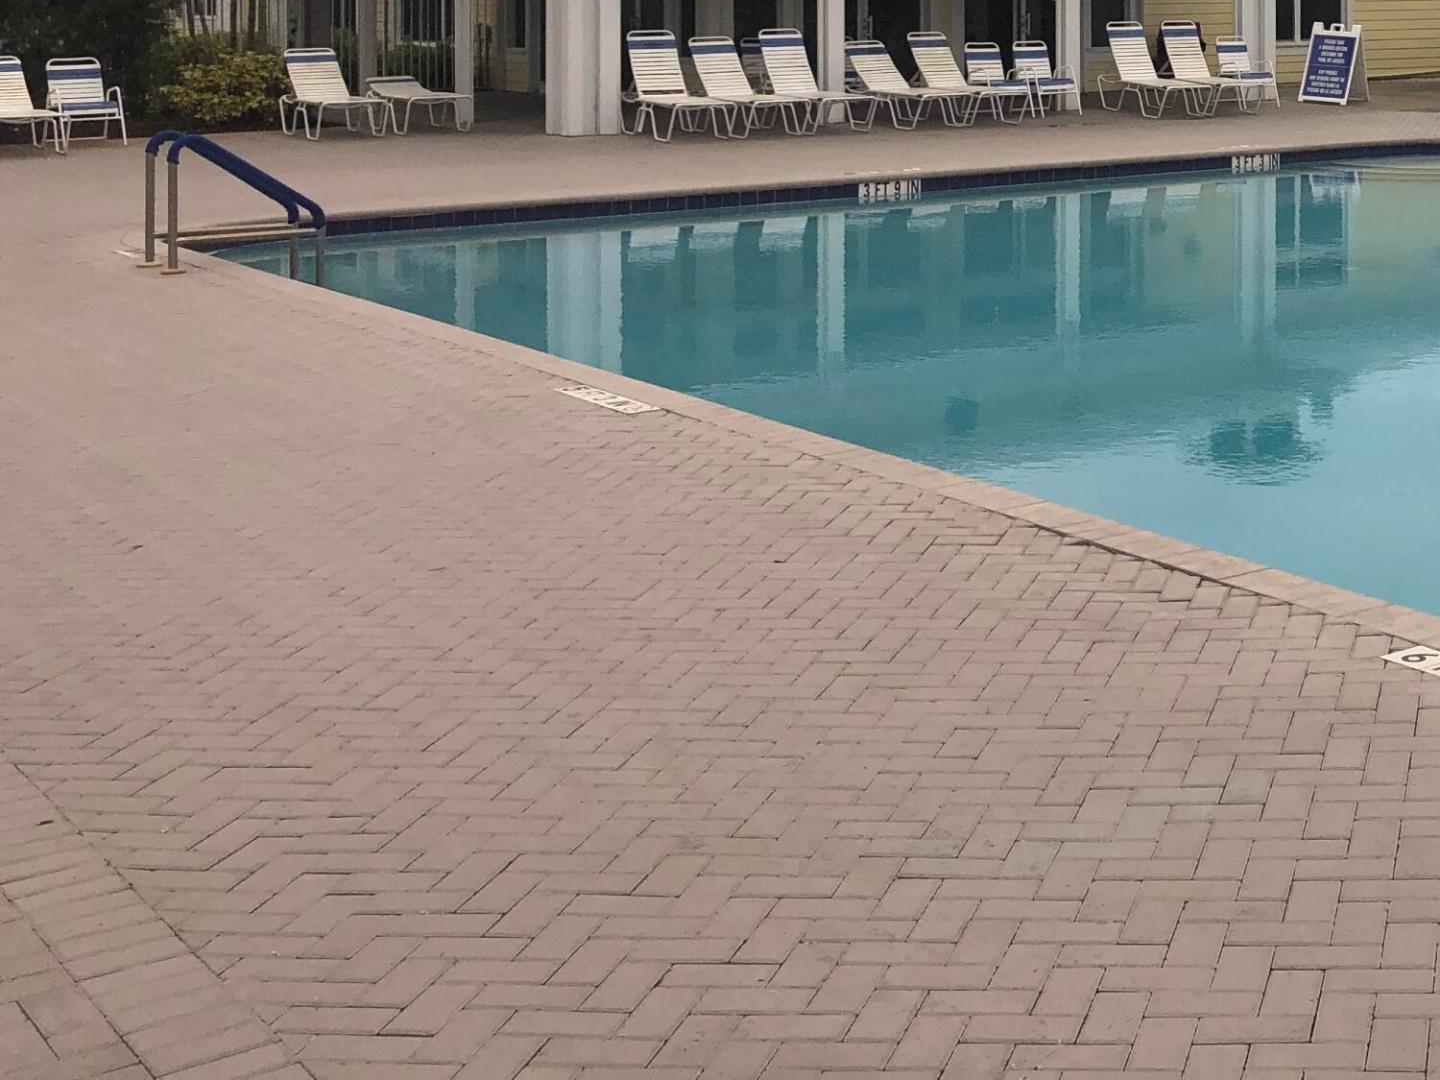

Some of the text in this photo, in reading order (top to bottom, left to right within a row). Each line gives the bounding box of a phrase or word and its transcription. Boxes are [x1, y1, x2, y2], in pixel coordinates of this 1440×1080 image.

[1244, 156, 1256, 169] FT
[1269, 153, 1279, 168] IN
[863, 179, 919, 197] 3 FT 9 IN
[1400, 653, 1440, 662] 6
